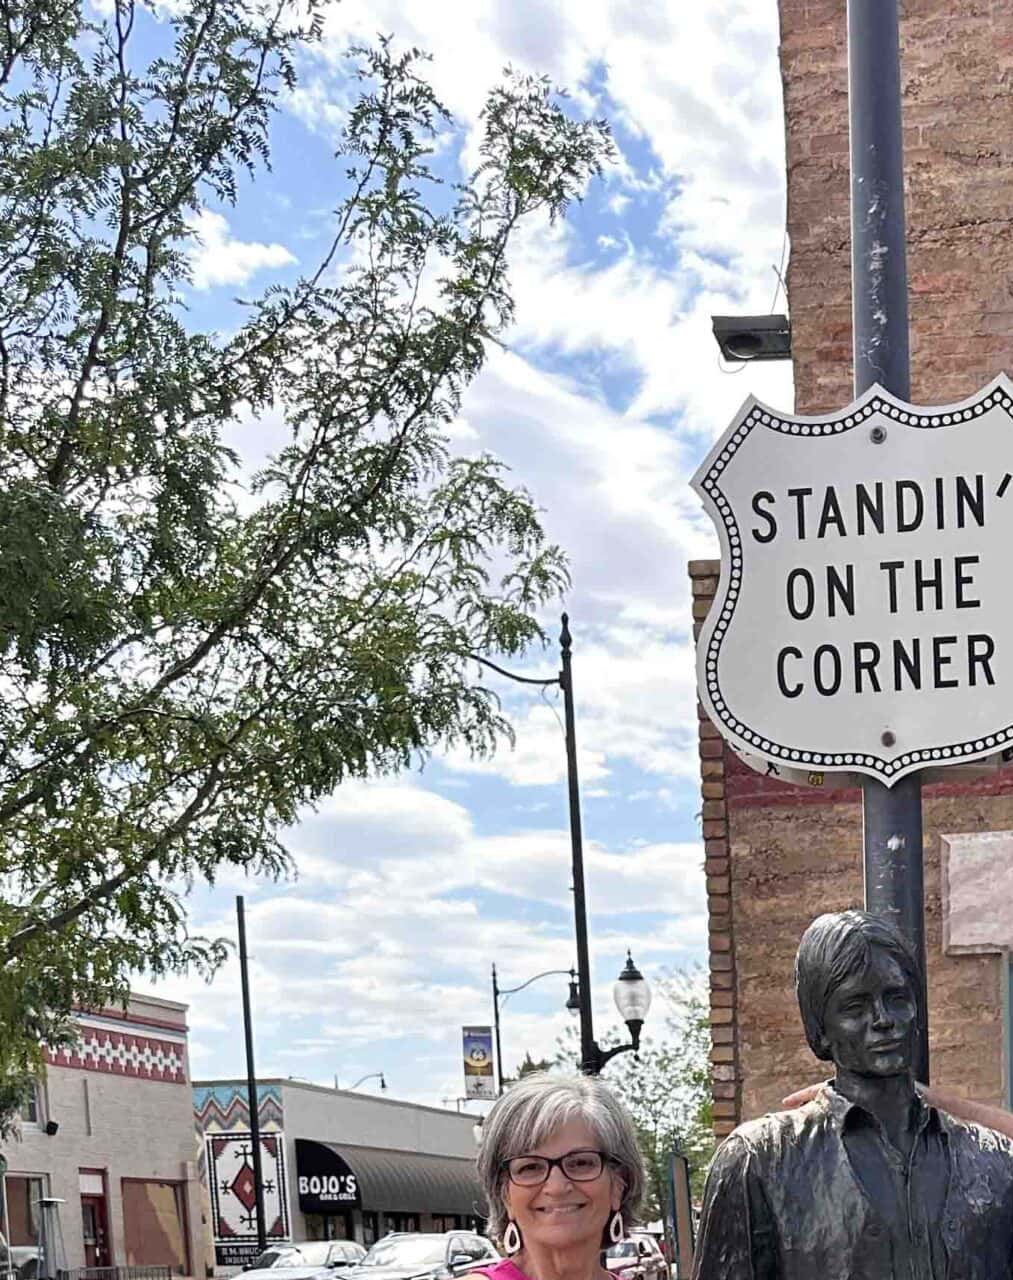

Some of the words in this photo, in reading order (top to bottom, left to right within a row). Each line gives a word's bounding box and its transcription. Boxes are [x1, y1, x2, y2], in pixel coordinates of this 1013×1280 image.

[751, 473, 1012, 544] STANDIN'
[786, 564, 856, 621] ON
[880, 555, 981, 614] THE
[777, 633, 996, 698] CORNER
[299, 1174, 357, 1194] BOJO'S
